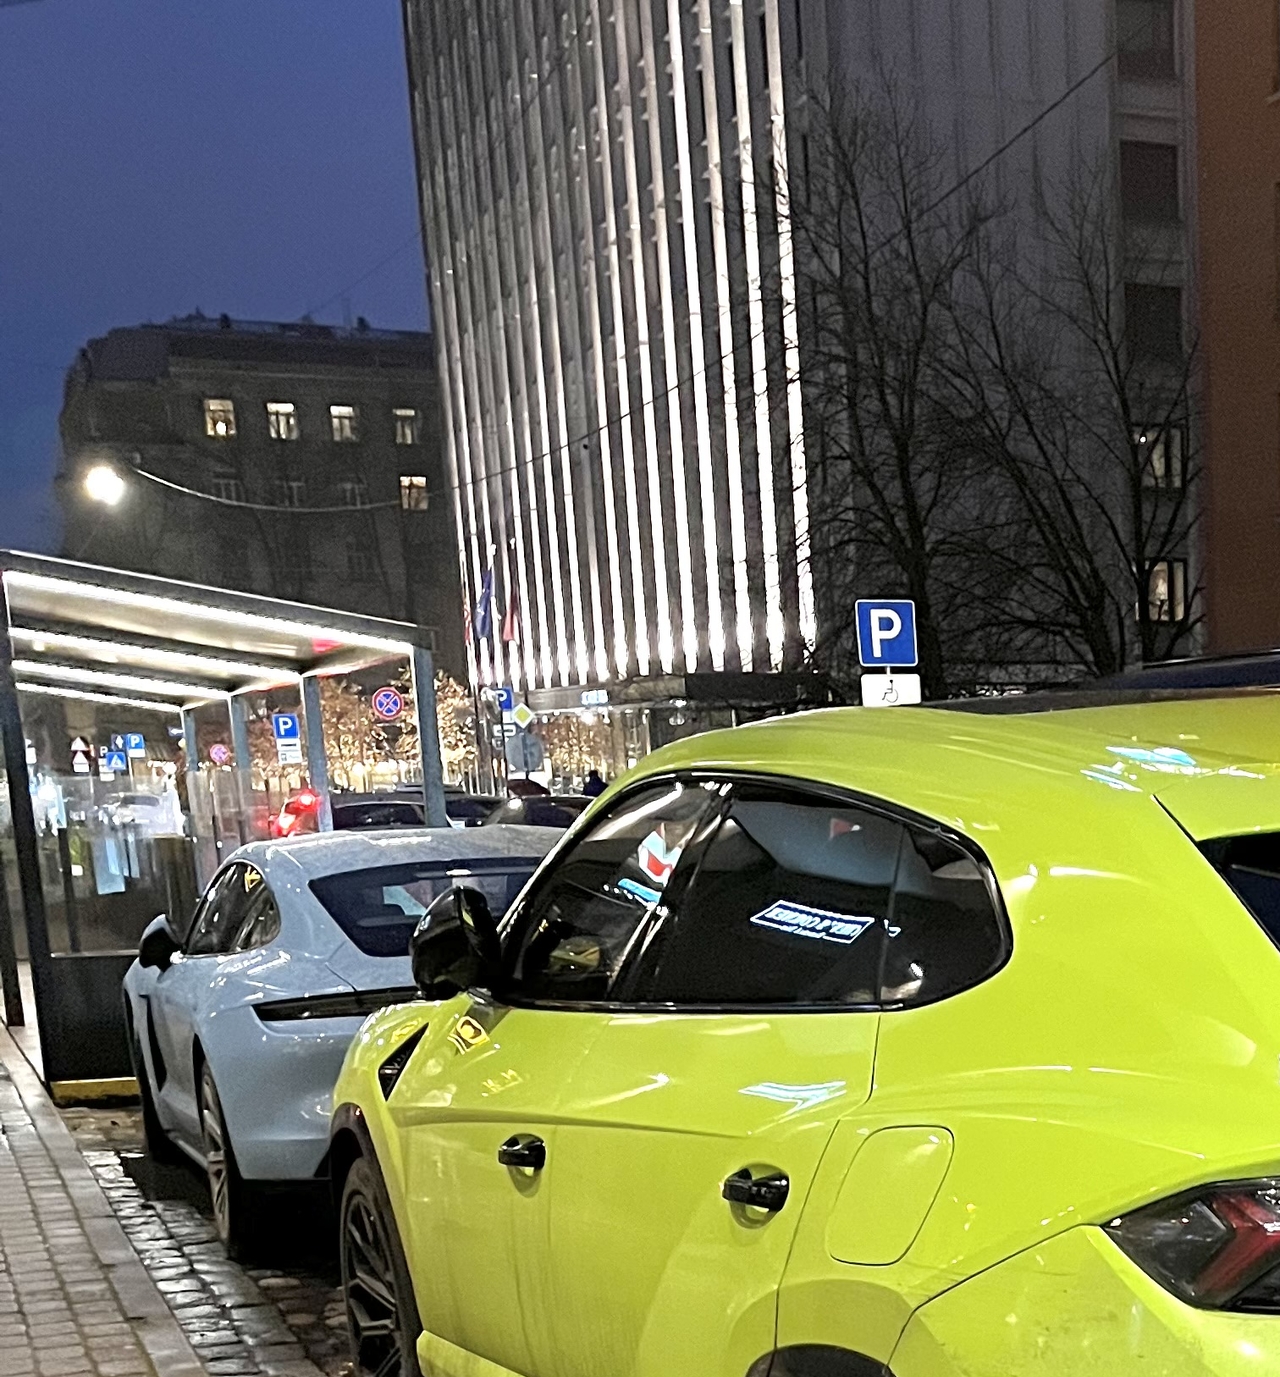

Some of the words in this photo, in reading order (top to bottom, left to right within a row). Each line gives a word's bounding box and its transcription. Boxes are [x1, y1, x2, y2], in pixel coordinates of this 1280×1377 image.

[870, 608, 902, 658] P
[278, 717, 293, 735] P
[130, 735, 140, 748] P
[100, 746, 108, 757] P
